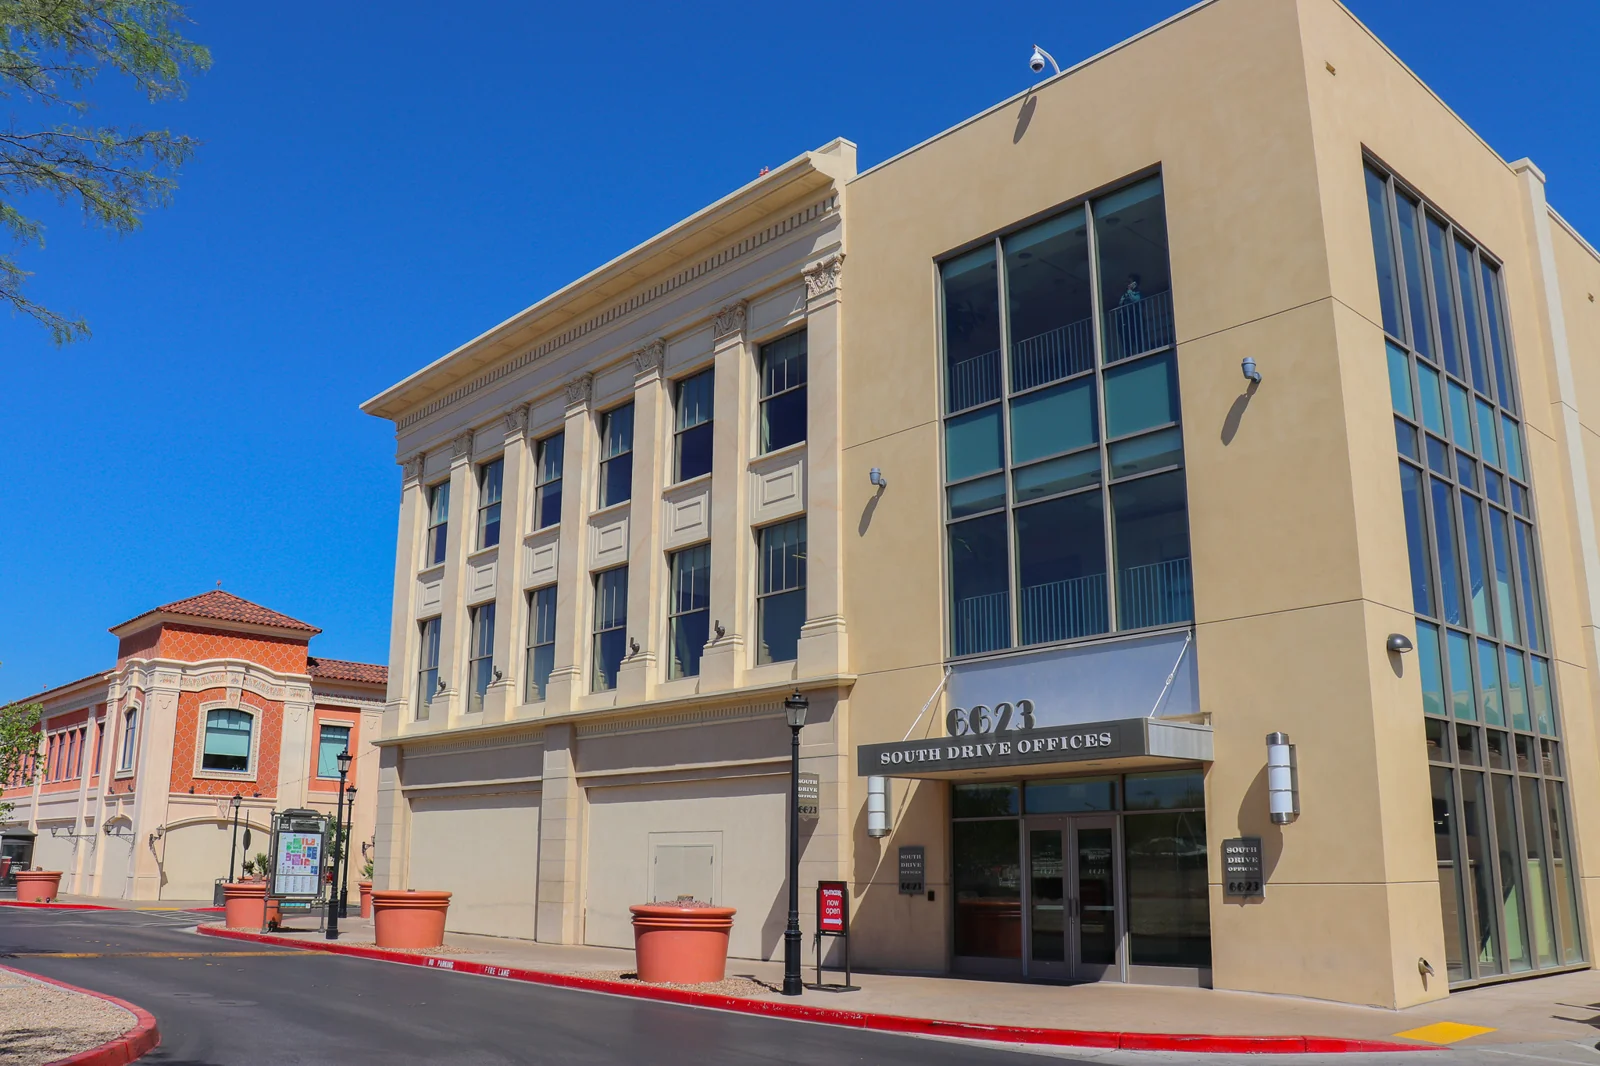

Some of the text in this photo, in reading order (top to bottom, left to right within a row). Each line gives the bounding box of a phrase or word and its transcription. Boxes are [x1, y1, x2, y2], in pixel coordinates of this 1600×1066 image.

[946, 699, 1036, 737] 6623
[880, 732, 1112, 765] SOUTH DRIVE OFFICES
[1229, 882, 1259, 892] 6623
[825, 908, 840, 916] open
[437, 960, 454, 969] PARKING
[485, 966, 510, 977] FIRE LANE
